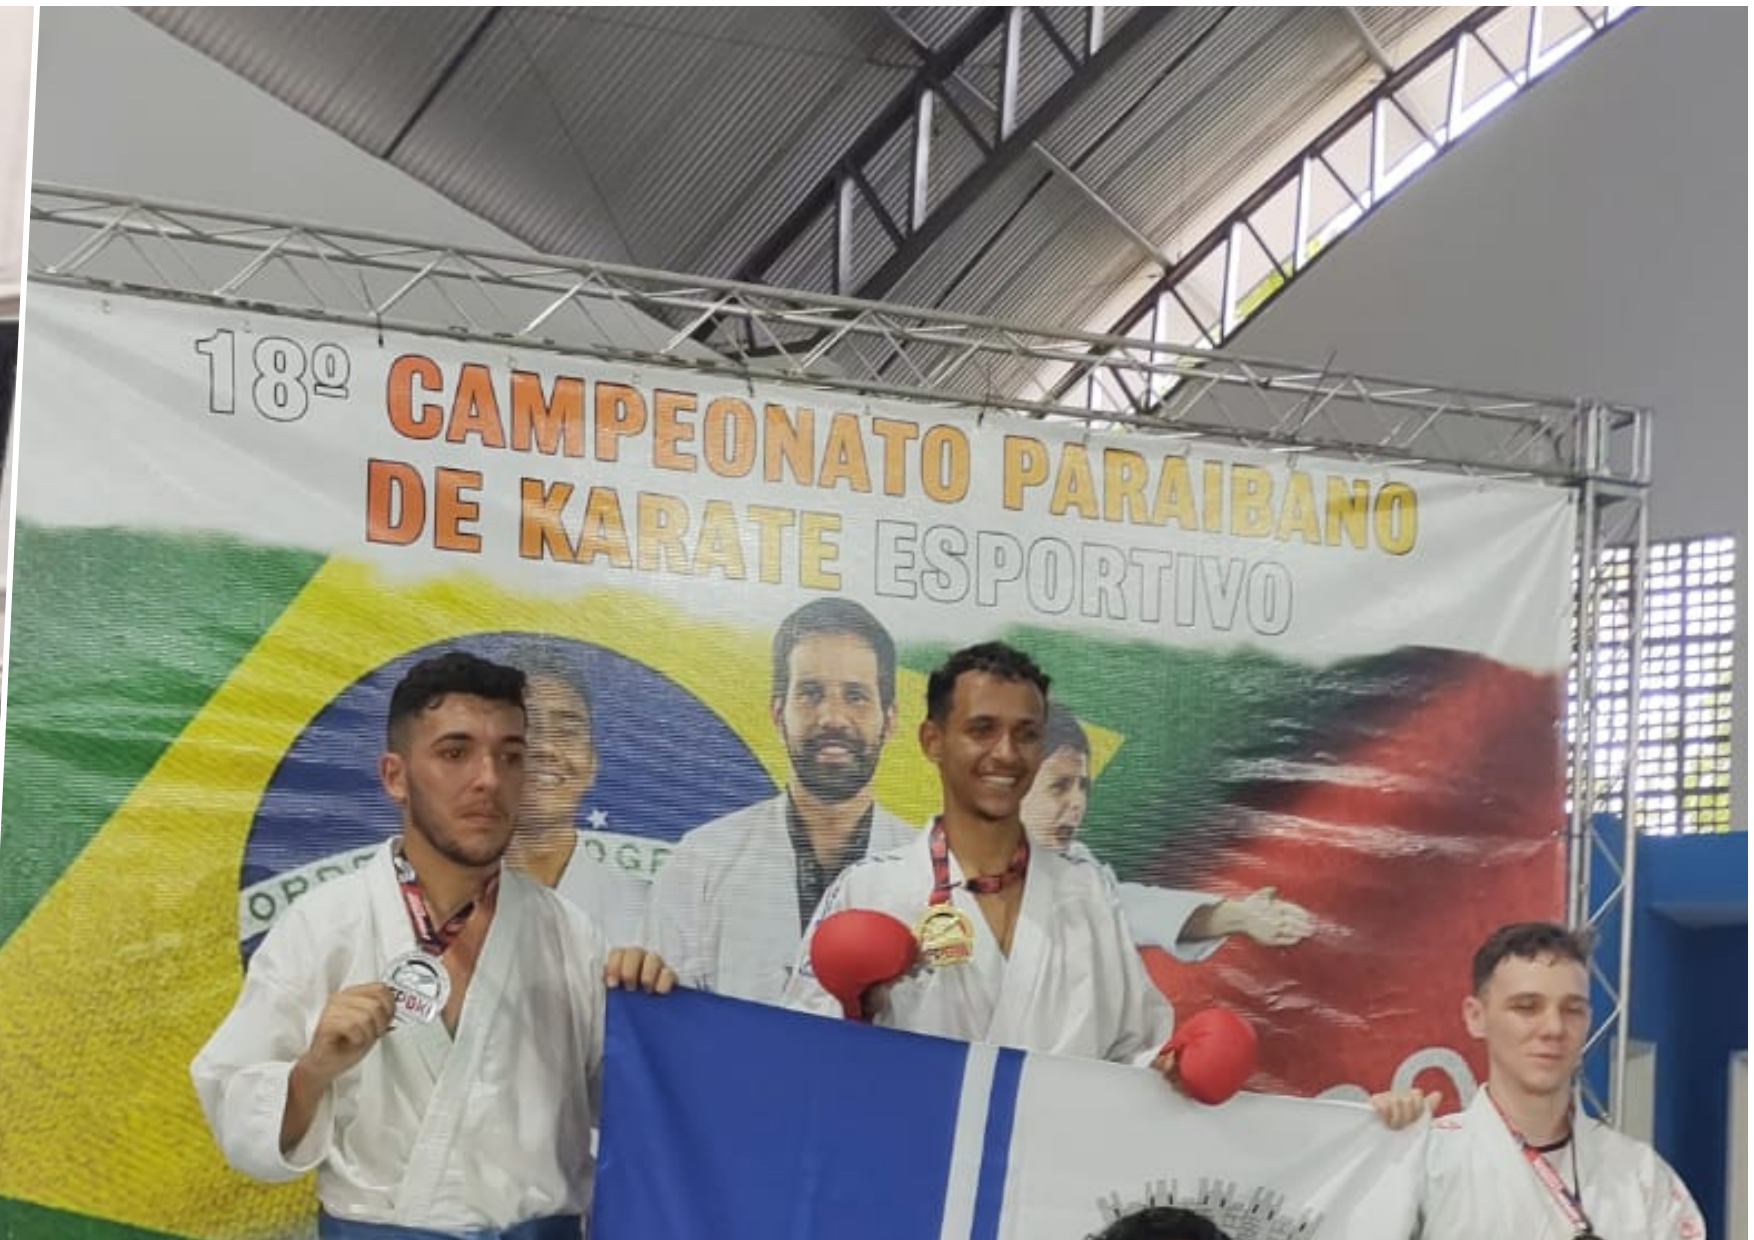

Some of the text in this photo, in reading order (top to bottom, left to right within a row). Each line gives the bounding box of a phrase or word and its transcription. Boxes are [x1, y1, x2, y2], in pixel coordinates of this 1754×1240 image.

[196, 329, 1419, 556] 18º CAMPEONATO PARAIBANO
[365, 458, 1294, 636] DE KARATE ESPORTIVO
